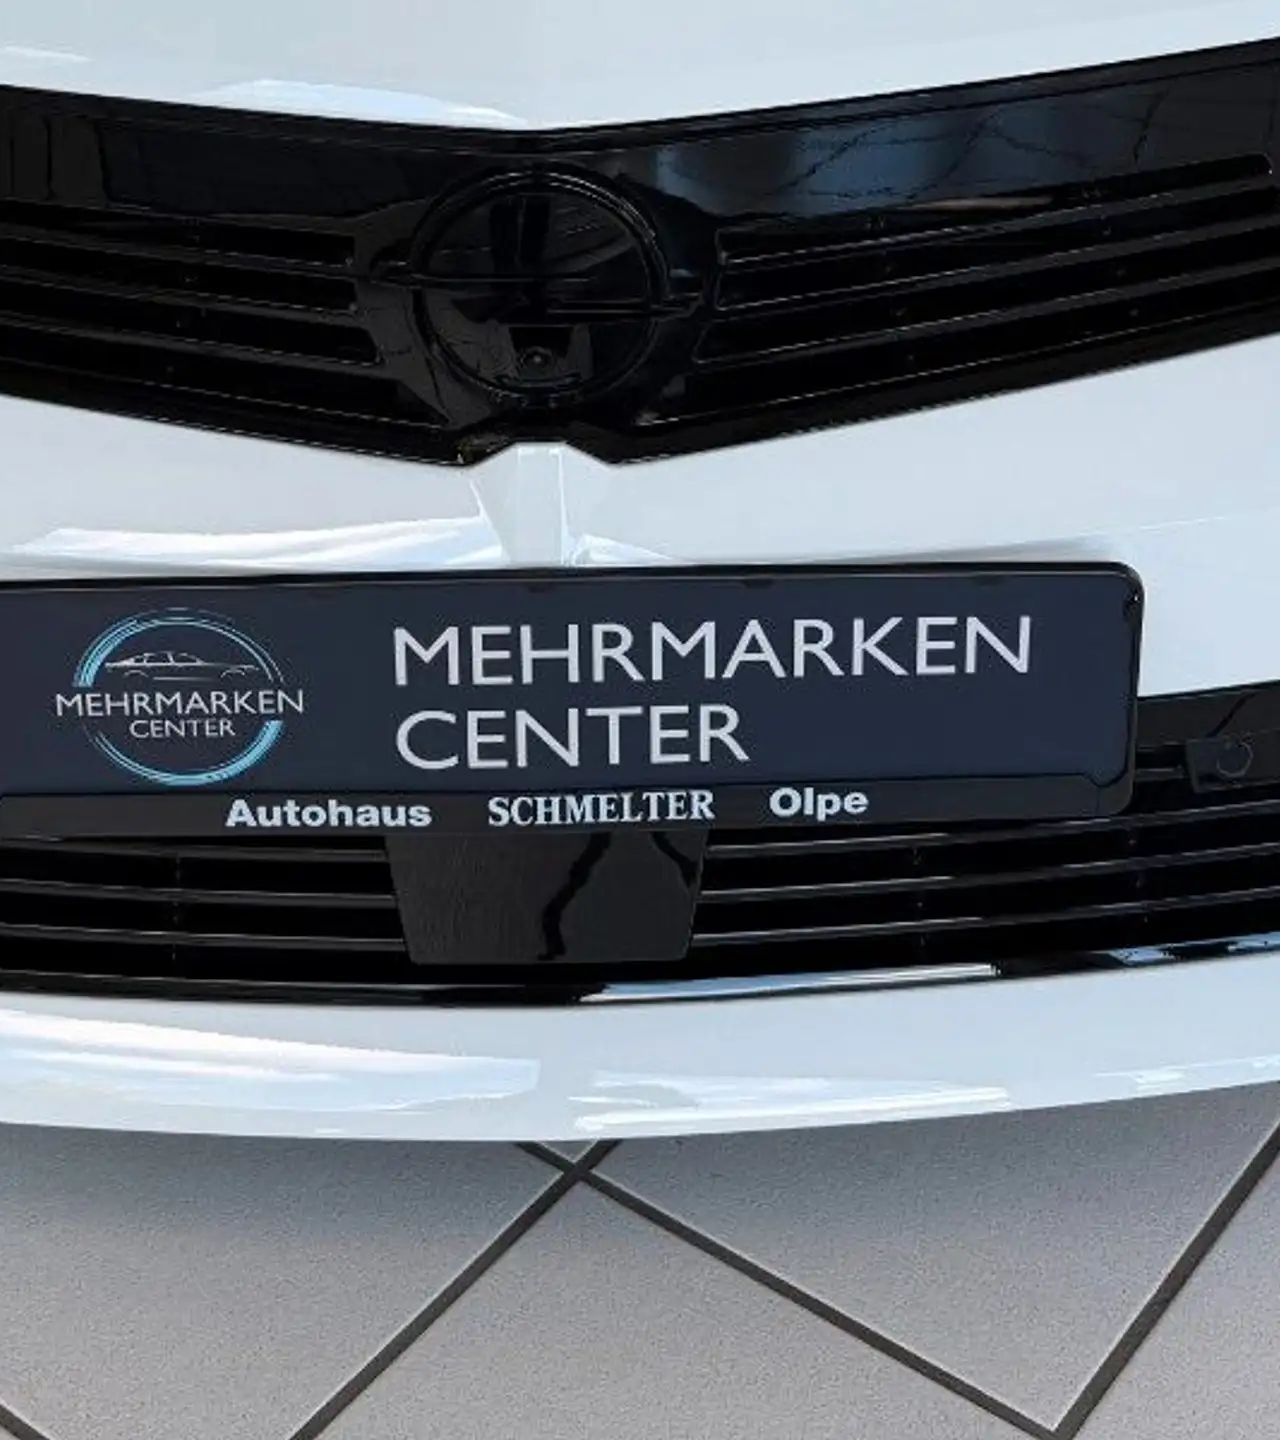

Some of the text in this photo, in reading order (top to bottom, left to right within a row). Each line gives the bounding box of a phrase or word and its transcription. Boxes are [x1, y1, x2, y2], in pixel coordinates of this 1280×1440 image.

[393, 616, 1031, 687] MEHRMARKEN
[55, 689, 305, 717] MEHRMARKEN
[129, 718, 236, 739] CENTER
[395, 704, 750, 771] CENTER
[225, 786, 870, 828] Autohaus SCHMELTER Olpe
